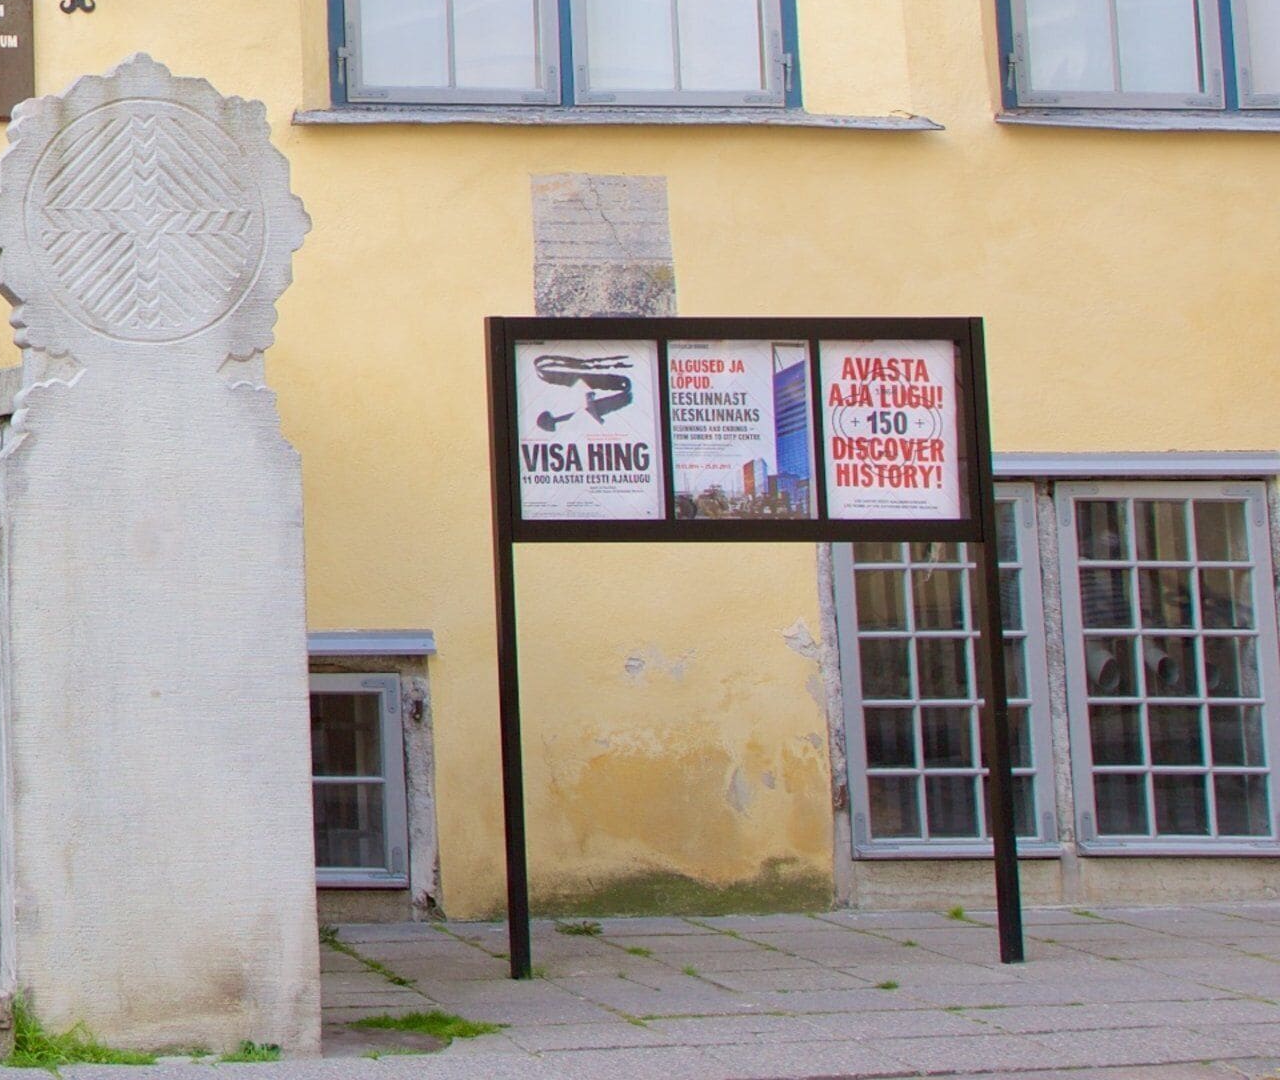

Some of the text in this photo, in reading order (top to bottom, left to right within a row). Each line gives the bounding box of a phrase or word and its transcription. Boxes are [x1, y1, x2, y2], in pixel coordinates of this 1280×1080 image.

[670, 360, 745, 373] ALGUSED JA
[842, 357, 929, 382] AVASTA
[671, 373, 714, 389] LÕPUD.
[671, 392, 747, 405] EESLINNAST
[829, 383, 943, 409] AJA LUGU!
[672, 408, 760, 422] KESKLINNAKS
[867, 411, 908, 435] 150
[521, 443, 583, 472] VISA
[587, 442, 650, 472] HING
[832, 436, 945, 462] DISCOVER
[522, 474, 650, 484] 11 000 AASTAT EESTI AJALUGU
[836, 463, 943, 489] HISTORY!
